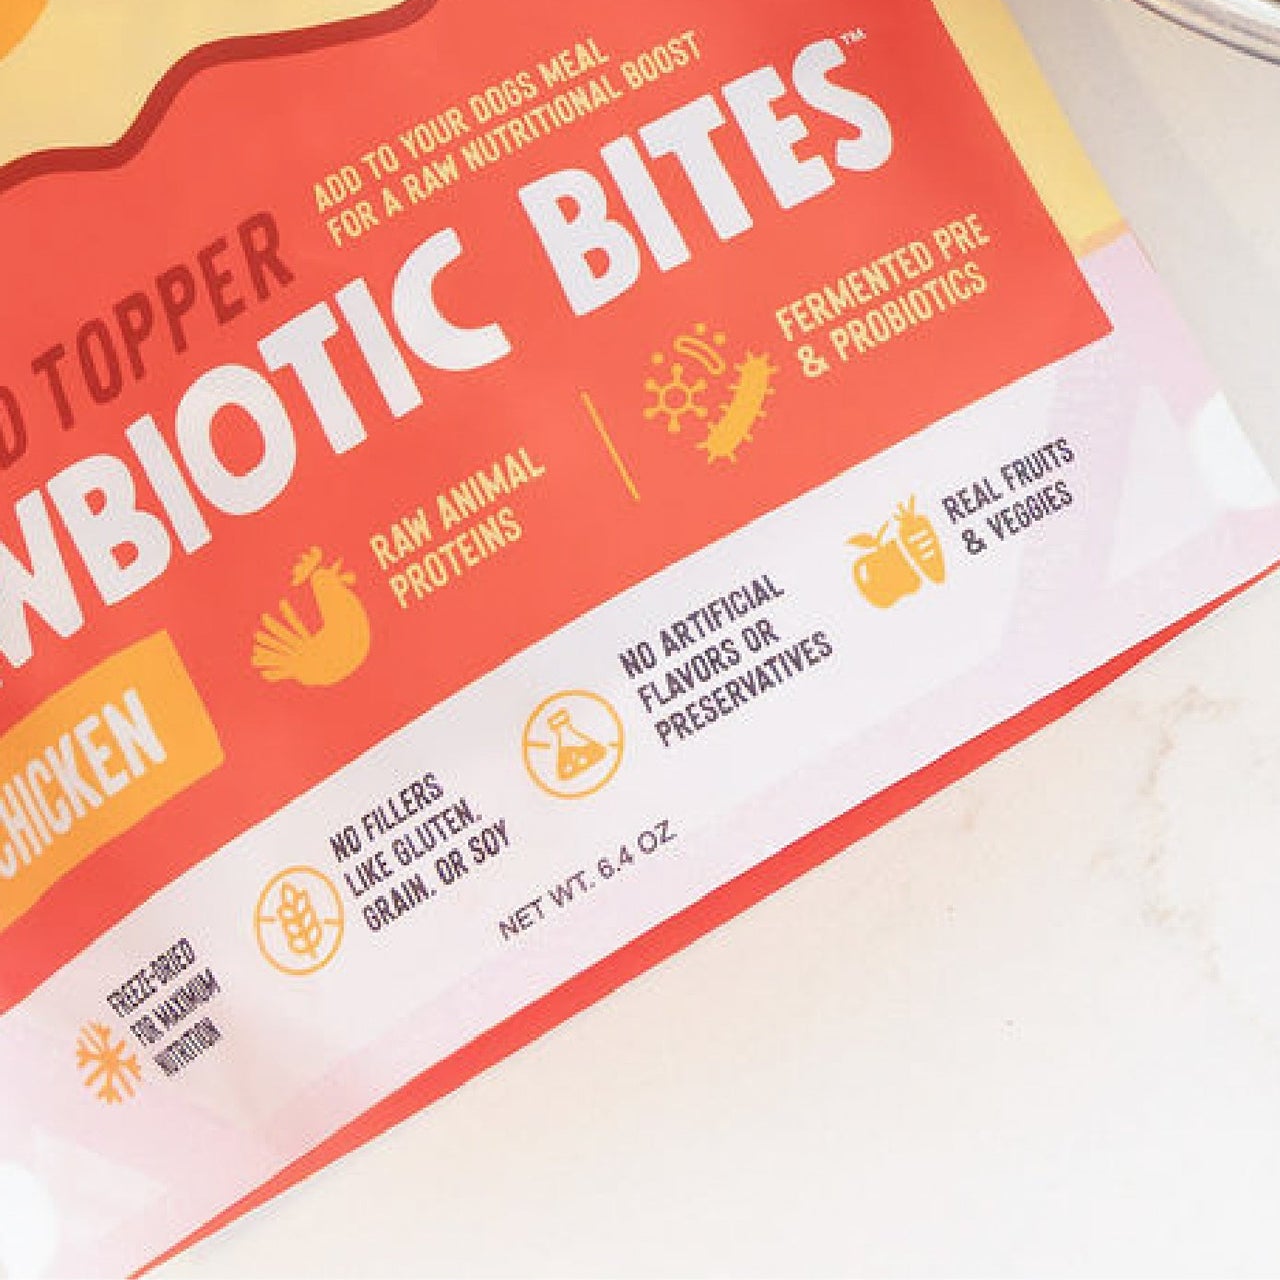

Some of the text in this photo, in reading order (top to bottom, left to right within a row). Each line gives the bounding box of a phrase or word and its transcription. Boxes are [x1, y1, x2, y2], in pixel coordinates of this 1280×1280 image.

[312, 36, 610, 214] ADD TO YOUR DOGS MEAL
[326, 29, 703, 248] FOR A RAW NUTRITIONAL BOOST
[31, 210, 297, 431] TOPPER
[775, 213, 991, 342] FERMENTED PRE
[797, 261, 988, 378] & PROBIOTICS
[0, 227, 512, 672] WBIOTIC
[942, 436, 1075, 525] REAL FRUITS
[369, 447, 546, 571] RAW ANIMAL
[389, 506, 522, 609] PROTEINS
[961, 479, 1074, 555] & VEGGIES
[617, 574, 785, 680] NO ARTIFICIAL
[637, 618, 782, 714] FLAVORS OR
[654, 630, 834, 748] PRESERVATIVES
[0, 686, 168, 879] HICKEN
[329, 771, 444, 864] NO FILLERS
[343, 850, 395, 898] LIKE
[434, 847, 469, 886] OR
[467, 817, 511, 865] SOY
[498, 818, 679, 941] NET WT. 6.4 OZ
[129, 966, 221, 1048] FOR MAXIMUM
[151, 1016, 222, 1077] NUTRITION
